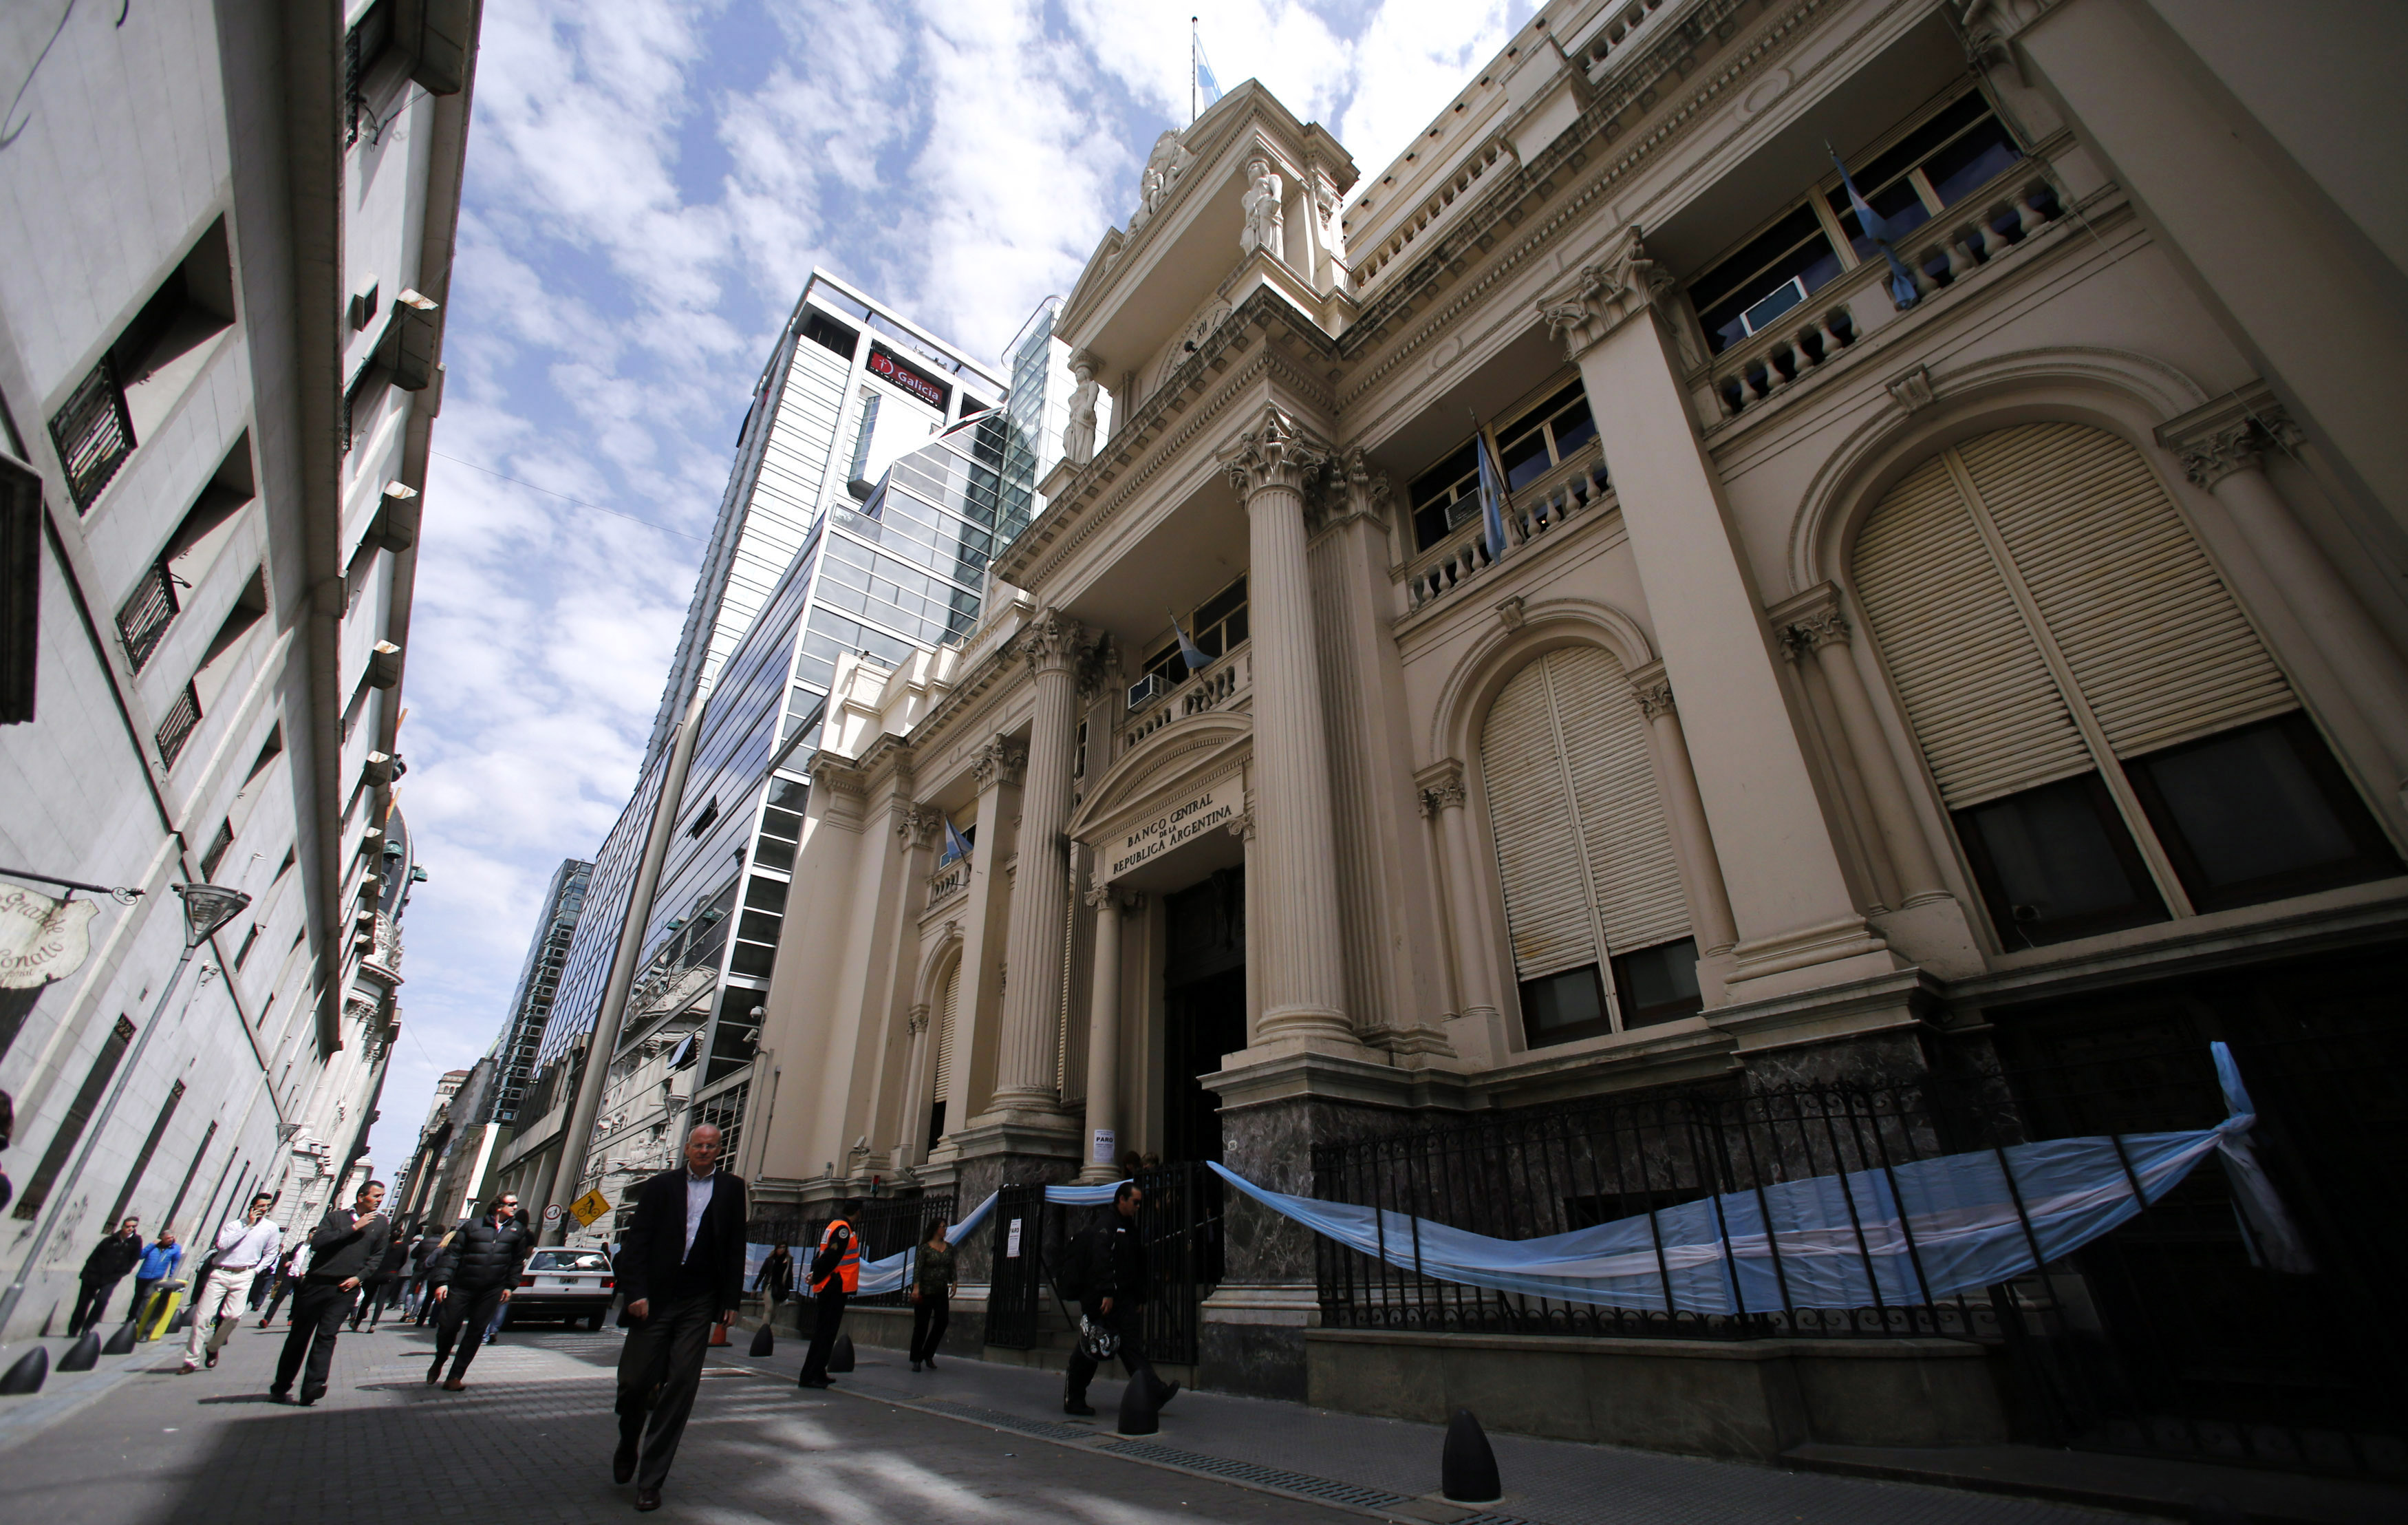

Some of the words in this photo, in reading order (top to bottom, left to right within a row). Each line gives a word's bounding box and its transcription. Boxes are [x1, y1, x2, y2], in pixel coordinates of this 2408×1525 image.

[898, 372, 938, 400] Galicia
[1112, 840, 1165, 874] REPUBLICA
[1170, 804, 1232, 845] ARGENTINA
[1127, 818, 1166, 847] BANCO
[1170, 793, 1213, 823] CENTRAL
[1159, 829, 1168, 838] DE
[1168, 824, 1177, 833] LA
